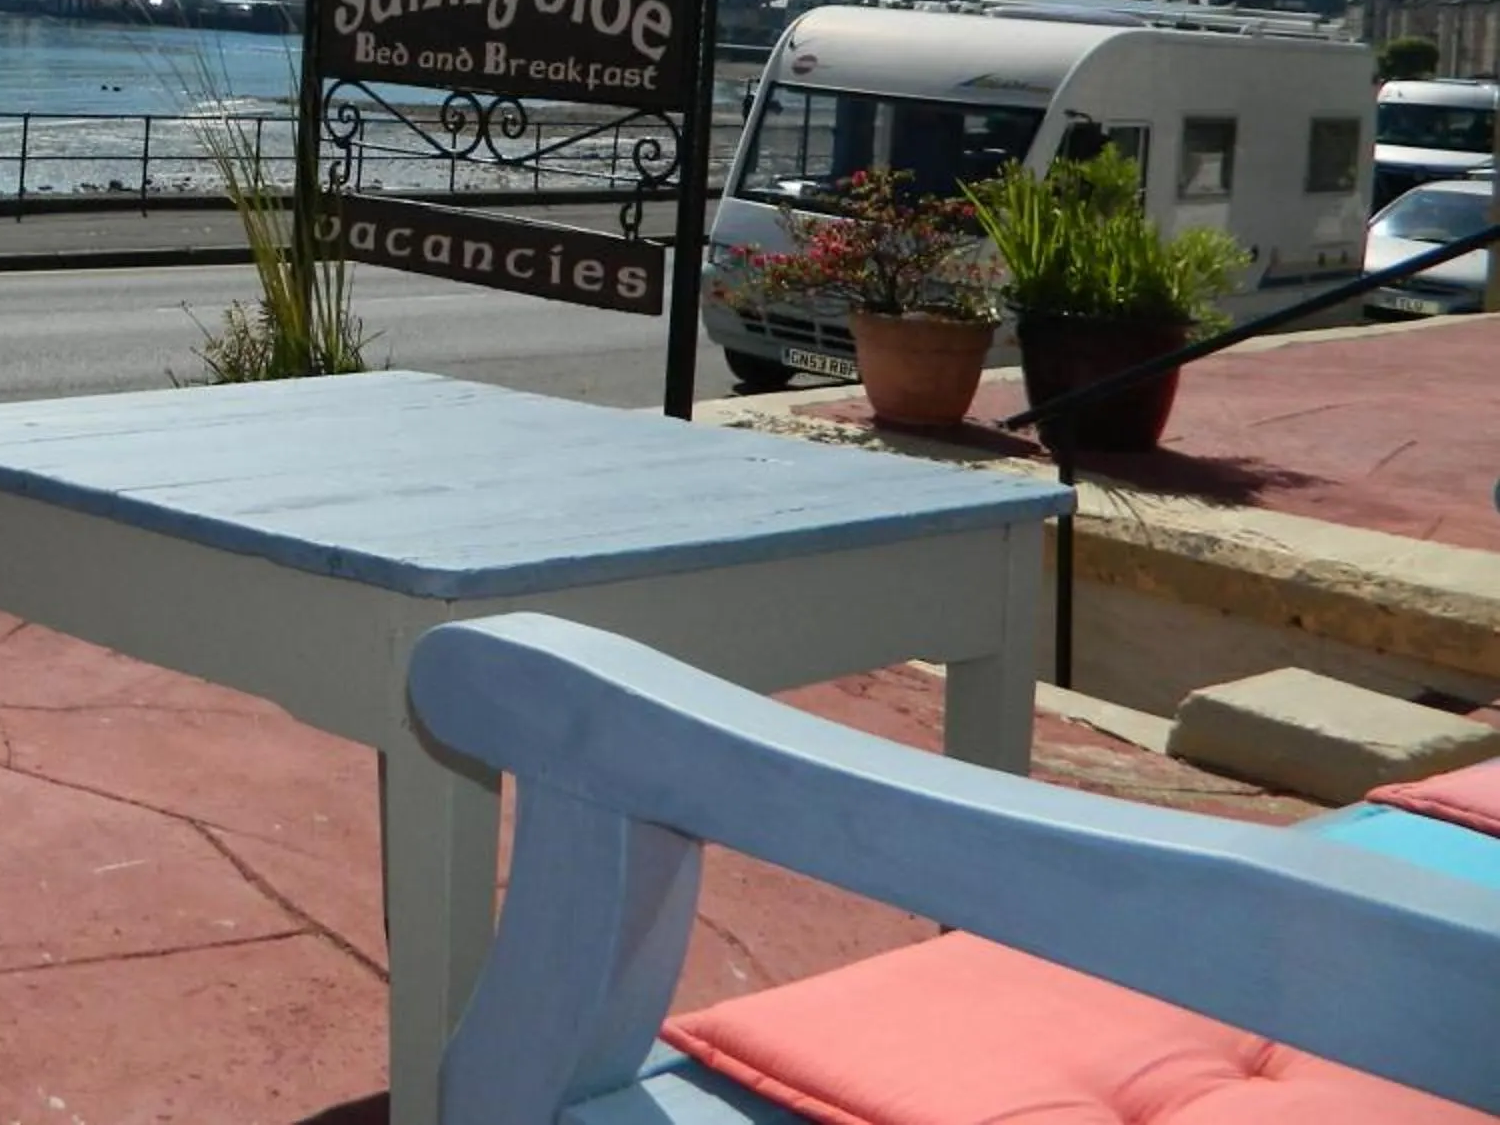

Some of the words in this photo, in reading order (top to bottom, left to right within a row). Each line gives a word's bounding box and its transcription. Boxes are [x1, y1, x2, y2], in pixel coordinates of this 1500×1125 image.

[355, 30, 409, 65] Bed
[418, 50, 474, 72] and
[484, 41, 659, 91] Breakfast
